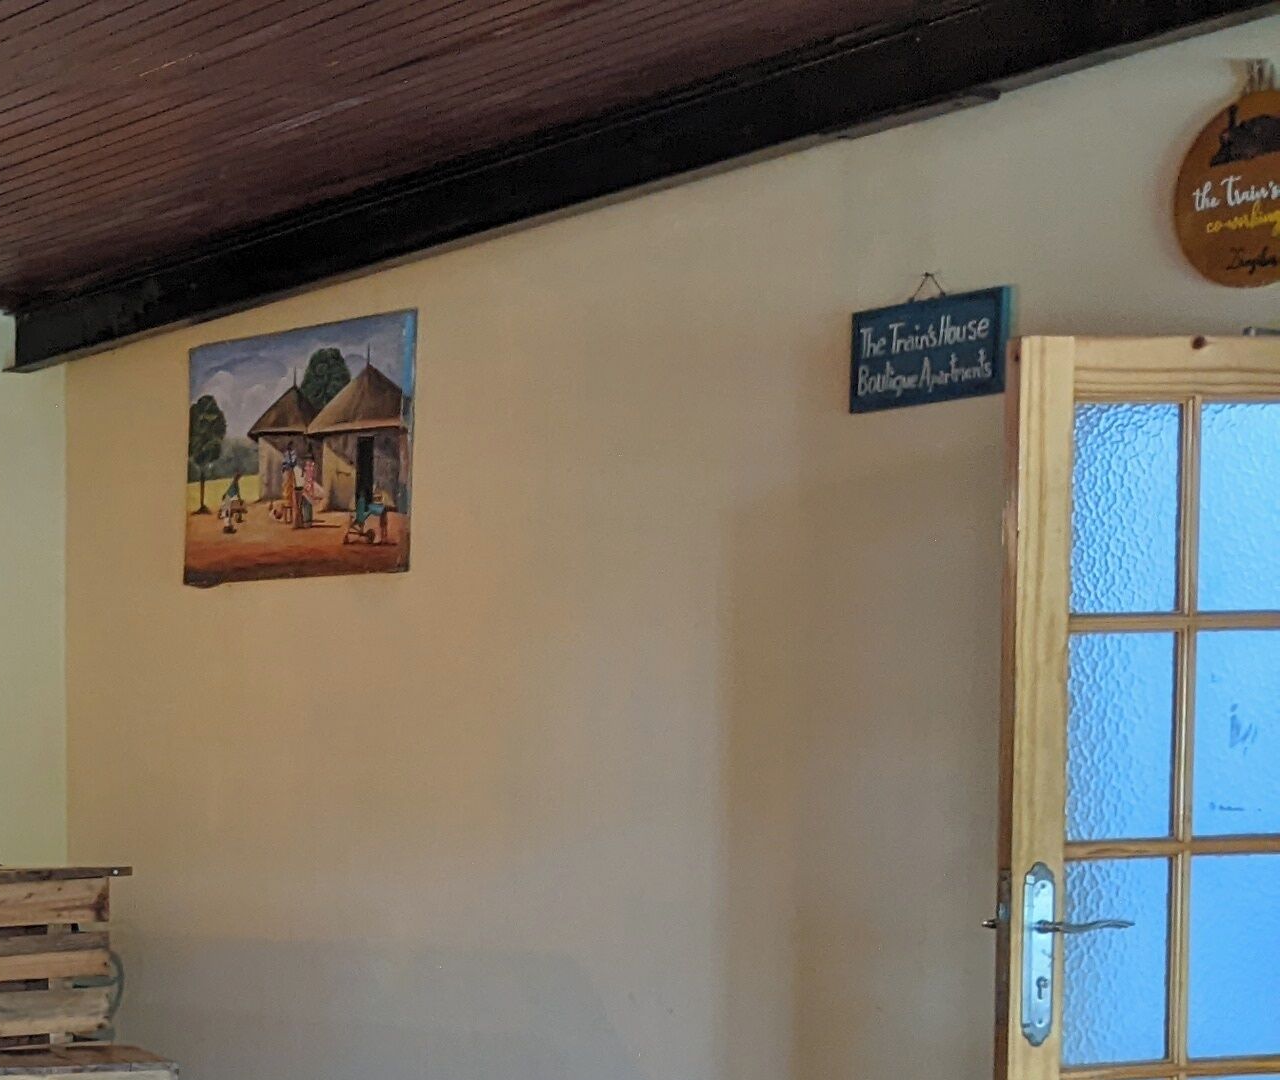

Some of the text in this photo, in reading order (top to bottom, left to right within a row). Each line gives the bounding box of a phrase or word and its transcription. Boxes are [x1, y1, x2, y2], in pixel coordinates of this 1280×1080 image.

[1192, 181, 1221, 212] the
[860, 327, 887, 359] The
[939, 314, 990, 347] House
